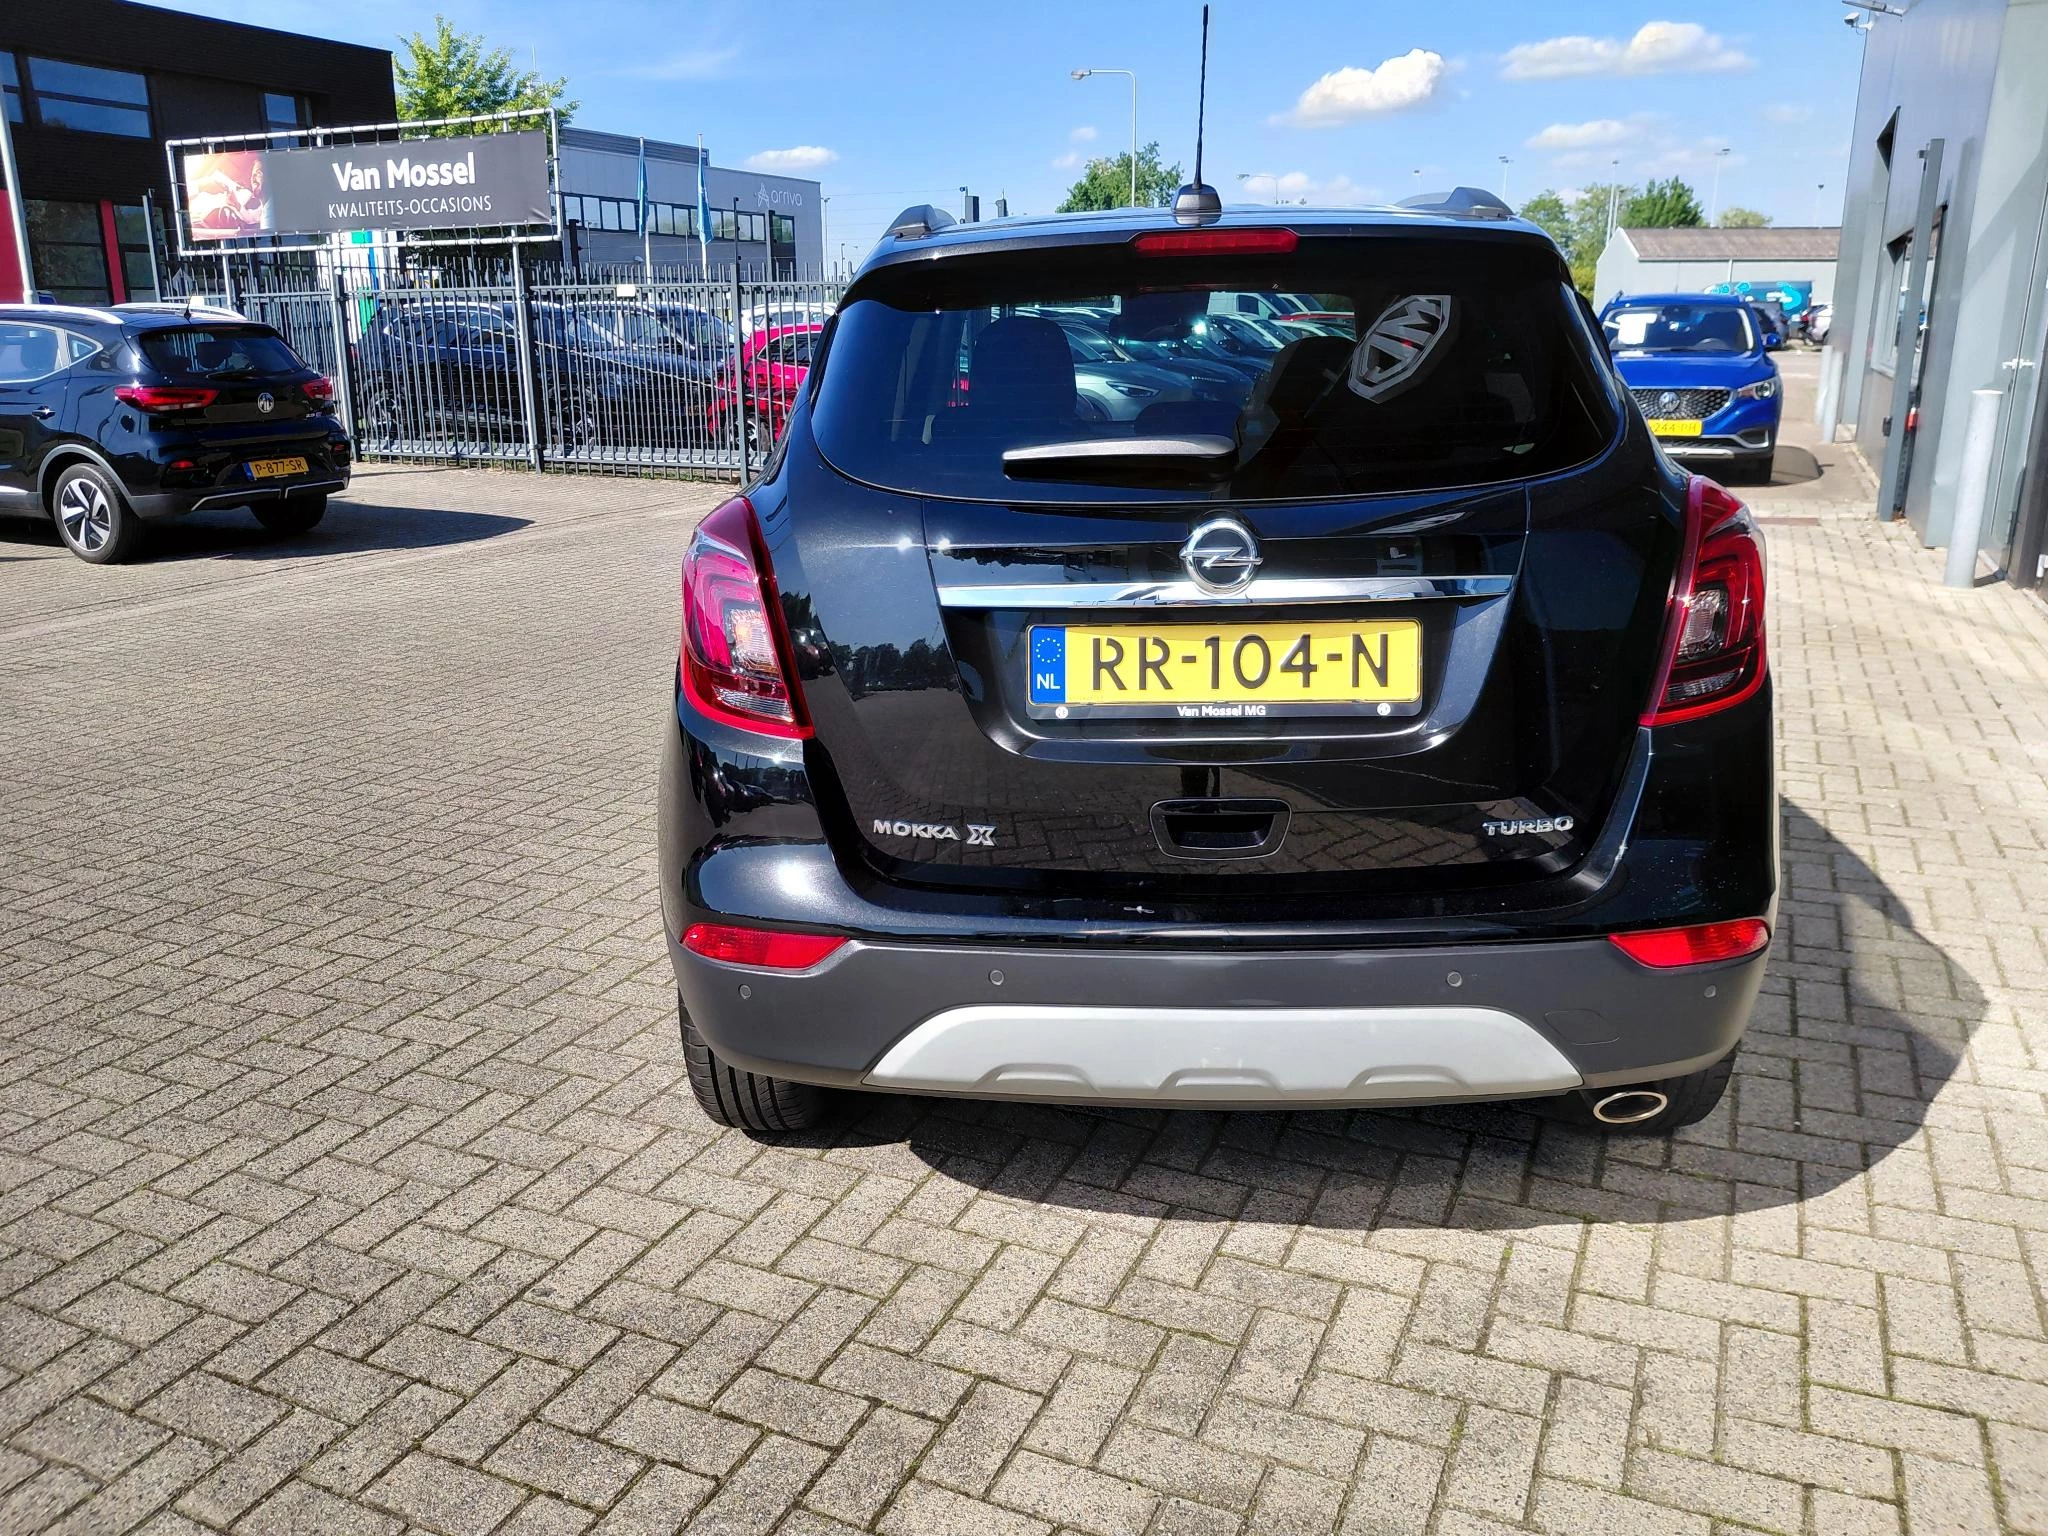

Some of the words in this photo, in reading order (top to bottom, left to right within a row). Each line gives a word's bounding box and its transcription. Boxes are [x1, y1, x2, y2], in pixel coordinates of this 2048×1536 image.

[331, 161, 381, 192] Van
[386, 151, 476, 189] Mossel
[328, 195, 492, 219] KWALITEITS-OCCASIONS
[770, 190, 803, 207] arriva
[254, 459, 305, 476] P-877-SR
[1092, 633, 1390, 691] RR-104-N
[1036, 673, 1061, 690] NL
[1176, 705, 1200, 717] Van
[1201, 705, 1242, 717] Mossel
[1244, 705, 1267, 716] MG
[873, 819, 961, 841] MOKKA
[966, 824, 997, 846] X
[1482, 815, 1574, 836] TURBO
